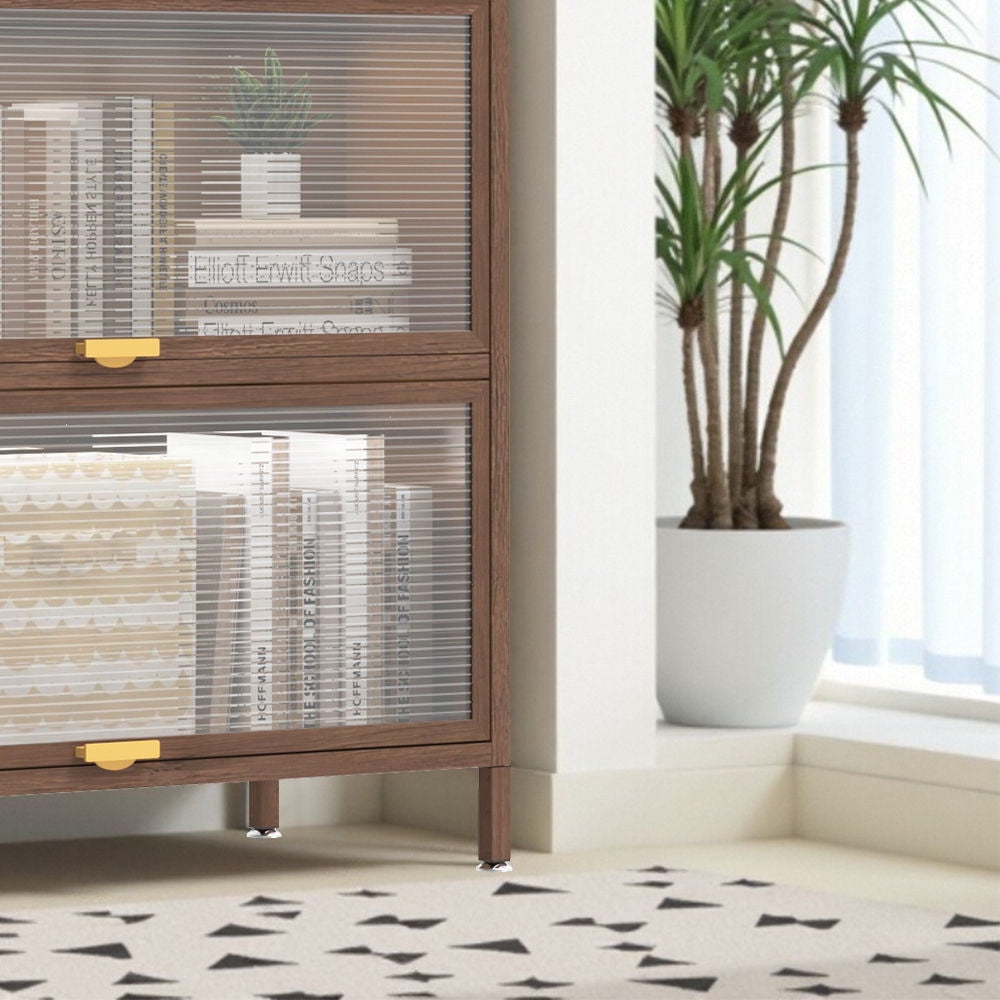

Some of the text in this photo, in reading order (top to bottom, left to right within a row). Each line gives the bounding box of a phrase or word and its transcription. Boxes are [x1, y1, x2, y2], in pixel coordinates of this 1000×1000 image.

[319, 255, 385, 286] Snaps
[203, 295, 258, 314] Cosmos
[303, 537, 316, 605] FASHION
[396, 534, 410, 601] FASHION
[303, 609, 316, 627] OF
[257, 646, 267, 721] HOFFMANN
[303, 635, 317, 696] SCHOOL
[353, 642, 361, 716] HOFFMANN
